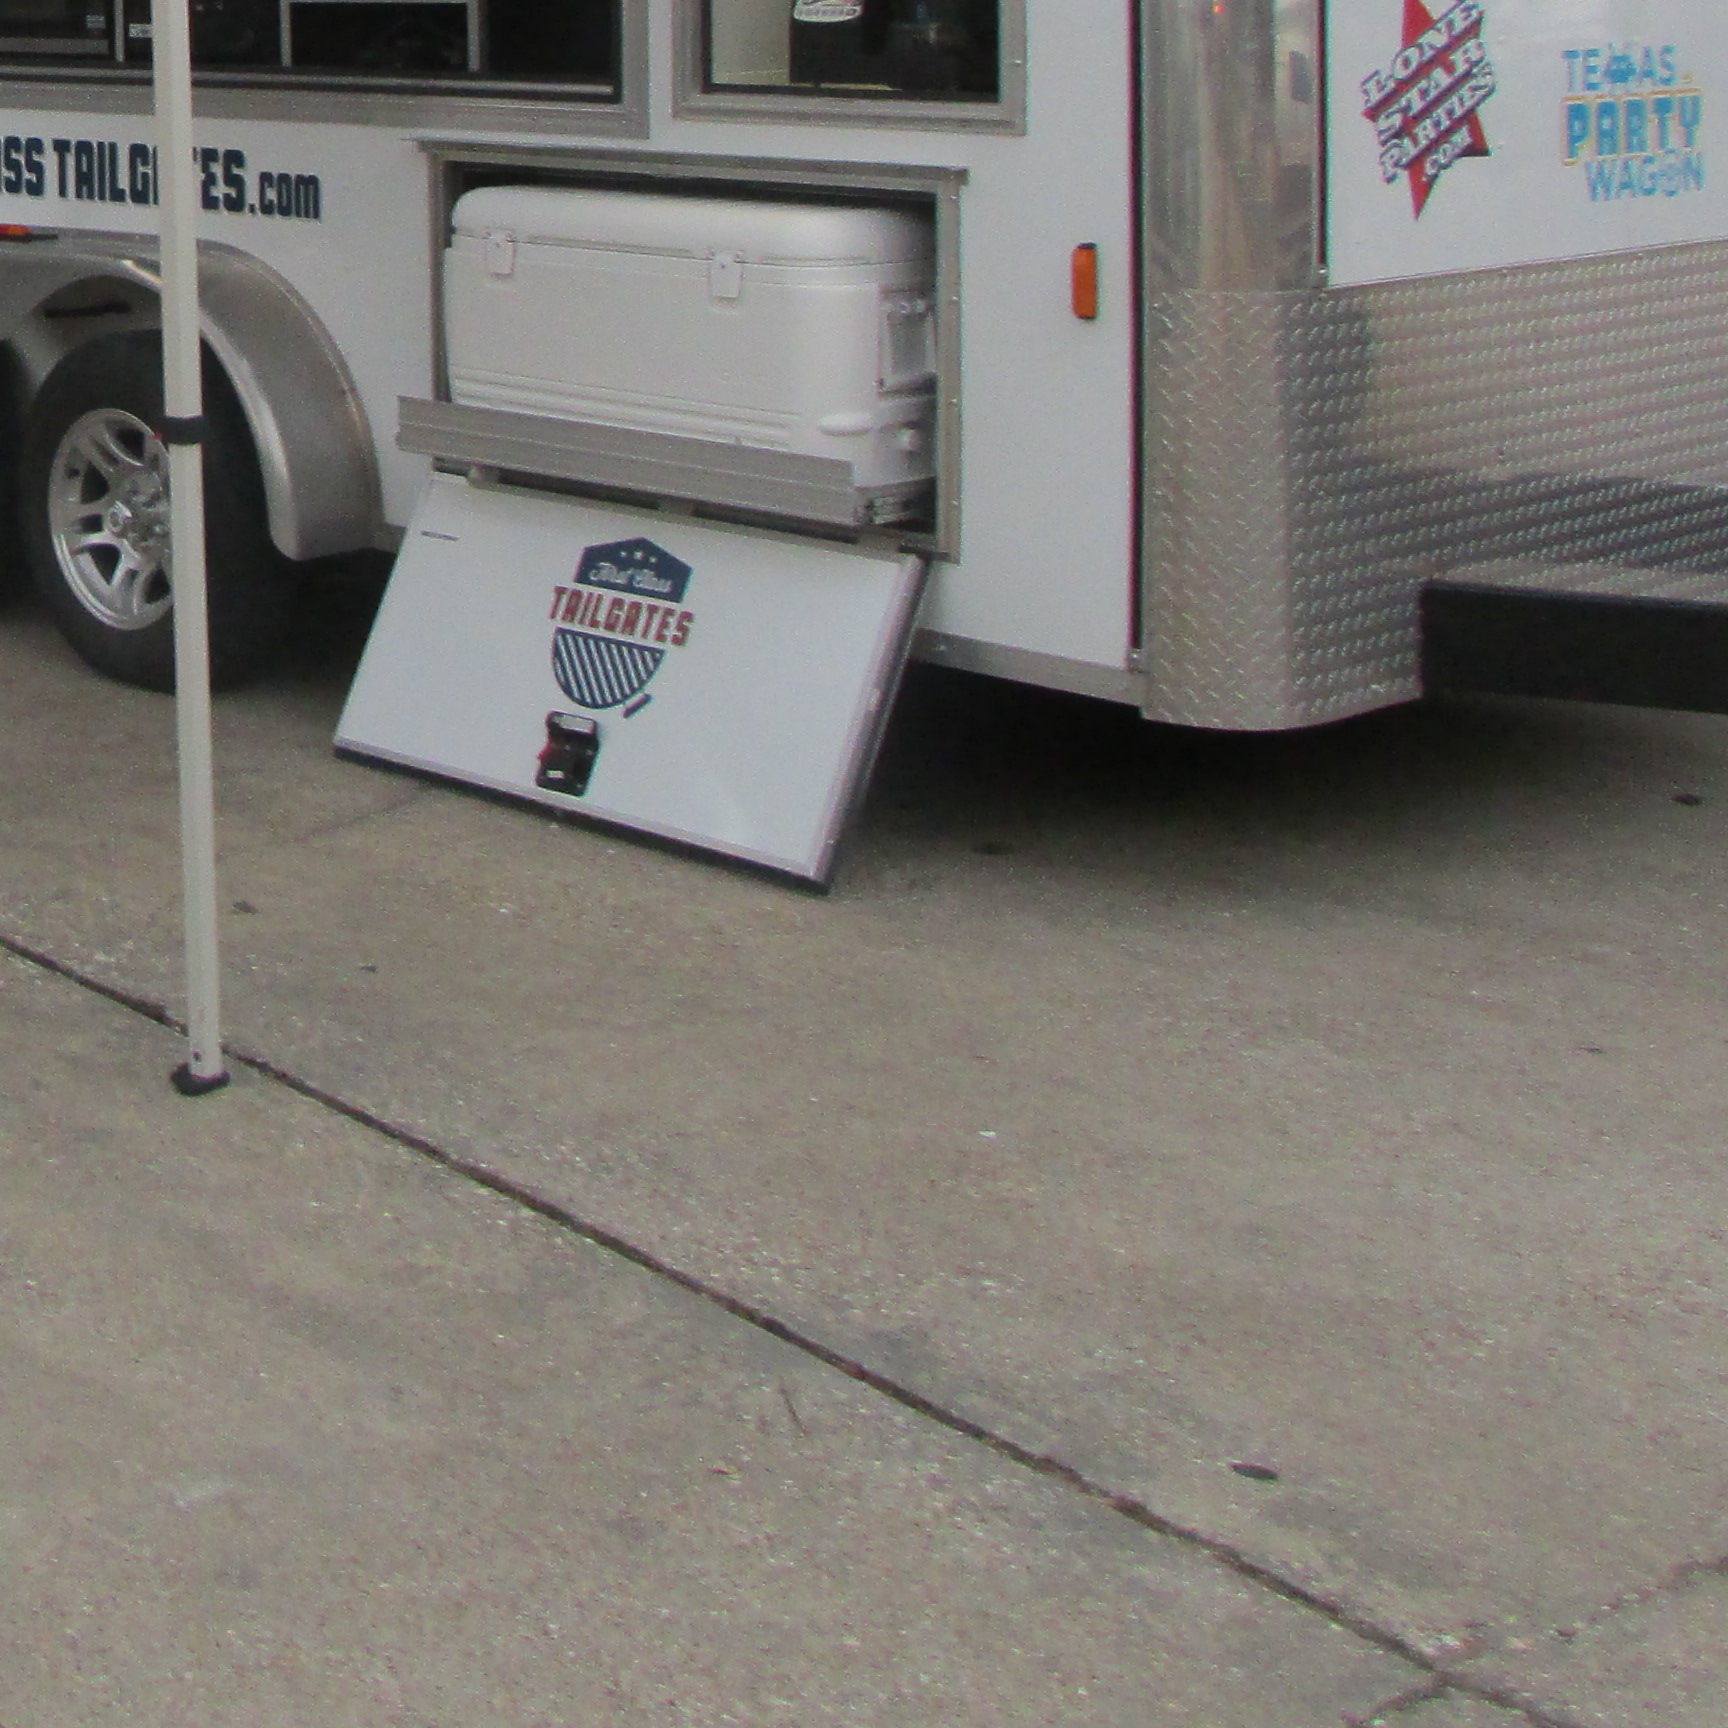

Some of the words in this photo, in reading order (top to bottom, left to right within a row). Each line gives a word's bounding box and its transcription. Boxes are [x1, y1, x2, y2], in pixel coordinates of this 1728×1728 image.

[1560, 88, 1702, 167] PARTY
[52, 138, 321, 220] TAILGES.com
[549, 585, 695, 646] TAILGATES
